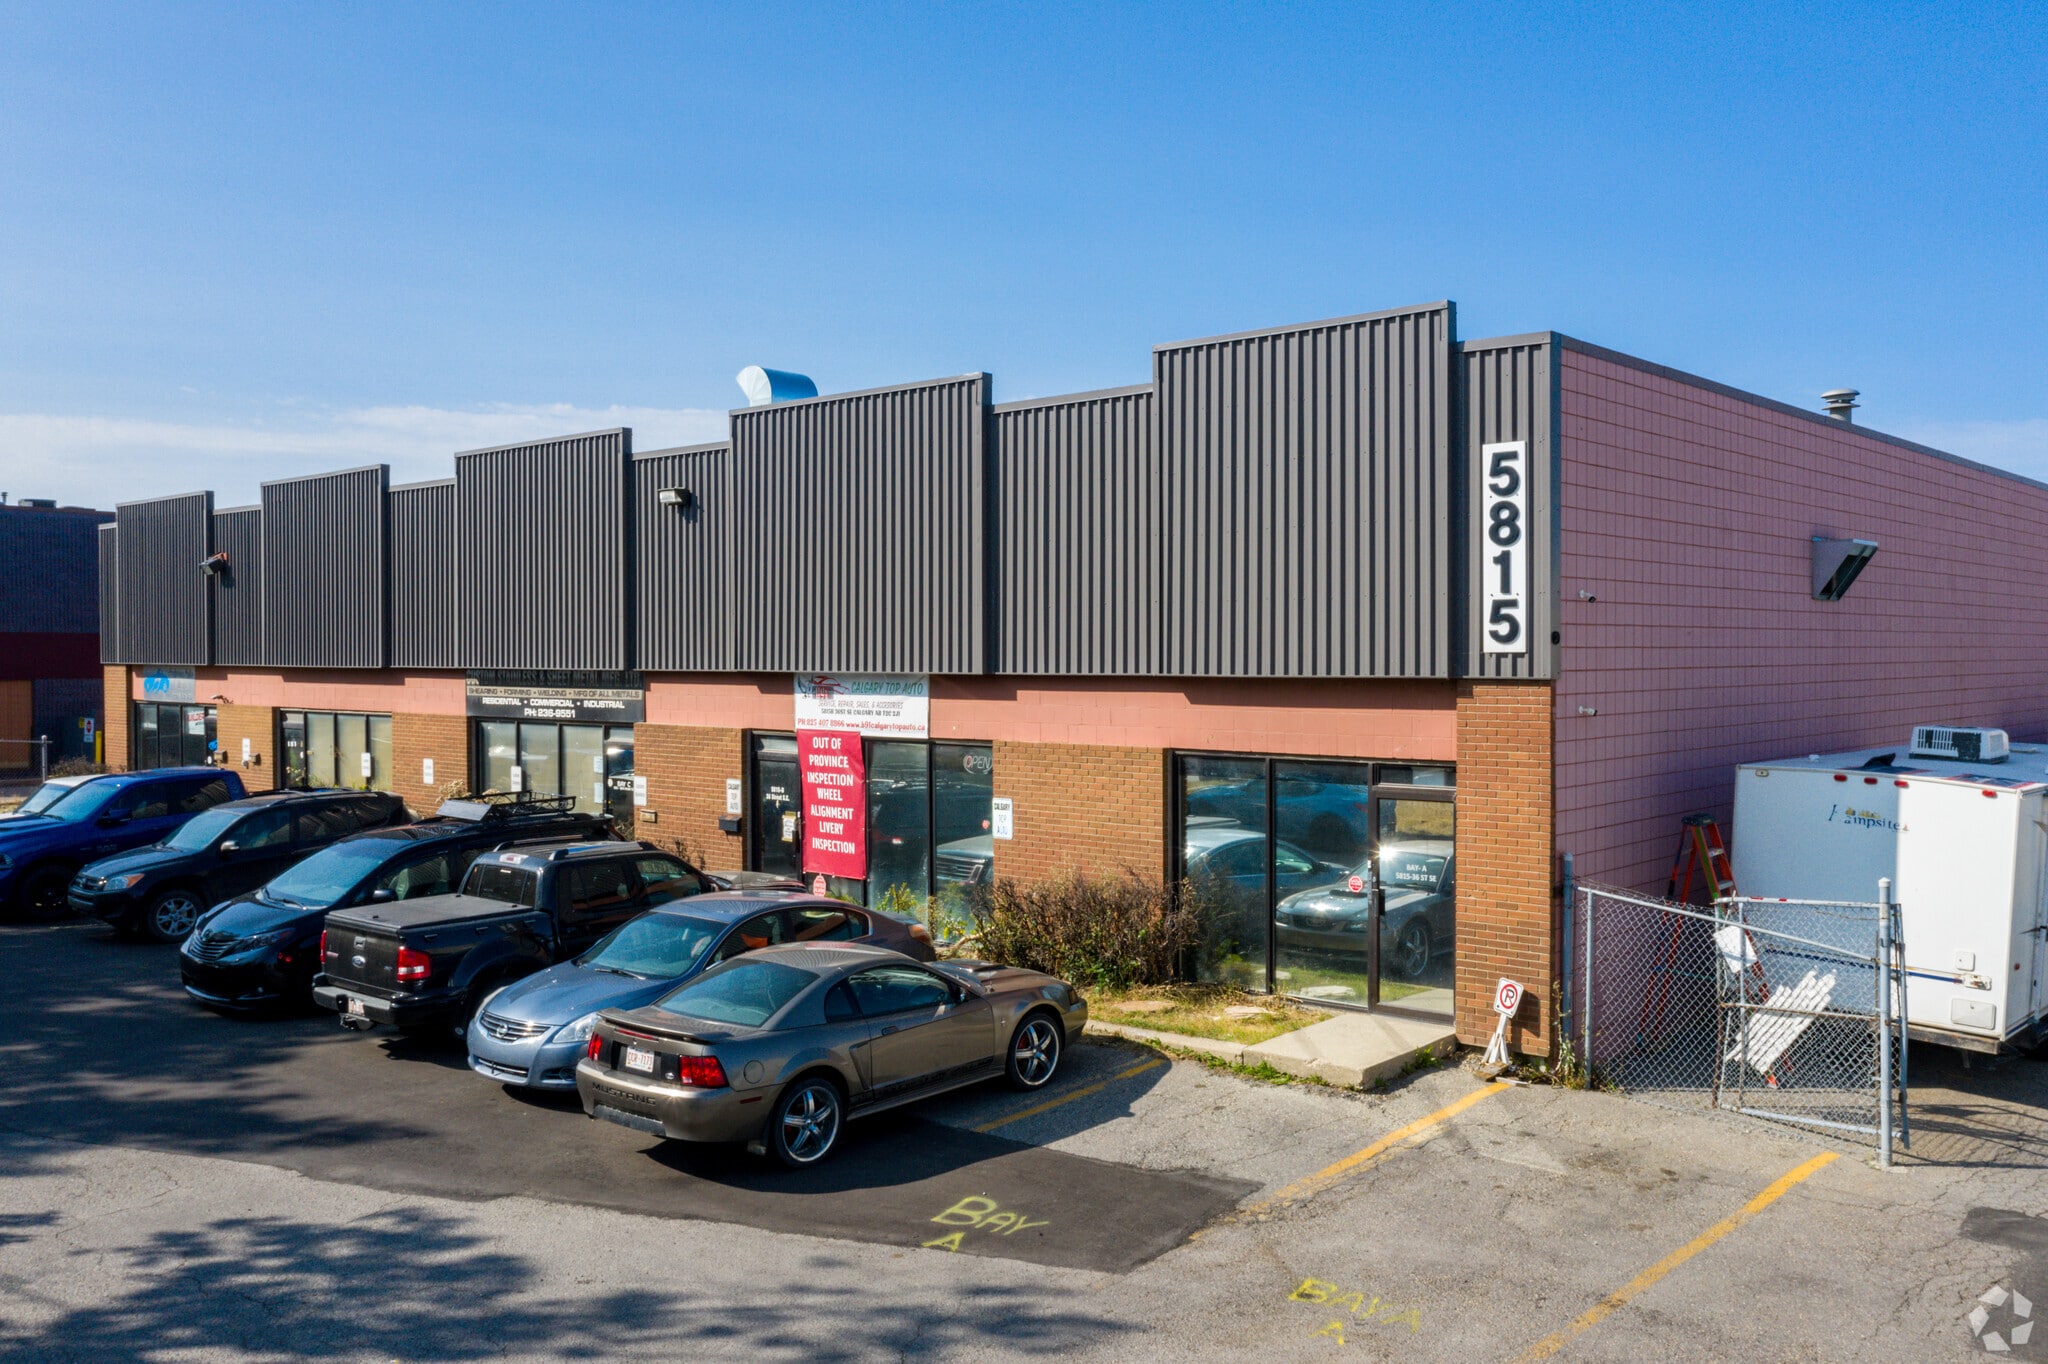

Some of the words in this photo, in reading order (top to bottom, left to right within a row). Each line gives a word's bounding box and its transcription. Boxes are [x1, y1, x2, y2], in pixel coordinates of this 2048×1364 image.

[1489, 451, 1521, 645] 5815
[497, 670, 538, 685] STAINLESS
[547, 671, 571, 686] SHEET
[573, 671, 600, 686] METAL
[468, 687, 498, 695] SHEARING
[503, 688, 531, 696] FORMING
[537, 689, 567, 697] WELDING
[851, 681, 883, 694] CALGARY
[886, 682, 900, 694] TOP
[902, 682, 923, 695] AUTO
[482, 697, 522, 706] RESIDENTIAL
[529, 698, 574, 707] COMMERCIAL
[583, 700, 625, 708] INDUSTRIAL
[524, 707, 537, 717] PH:
[538, 708, 576, 718] 236-9551
[812, 736, 829, 749] OUT
[831, 737, 842, 750] OF
[809, 754, 849, 768] PROVINCE
[965, 755, 991, 769] OPEN
[807, 771, 854, 786] INSPECTION
[816, 787, 843, 801] WHEEL
[810, 804, 854, 820] ALIGNMENT
[819, 821, 843, 835] LIVERY
[812, 837, 855, 854] INSPECTION
[592, 1082, 656, 1105] MUSTANG
[931, 1195, 1049, 1236] BAY
[921, 1231, 966, 1254] A
